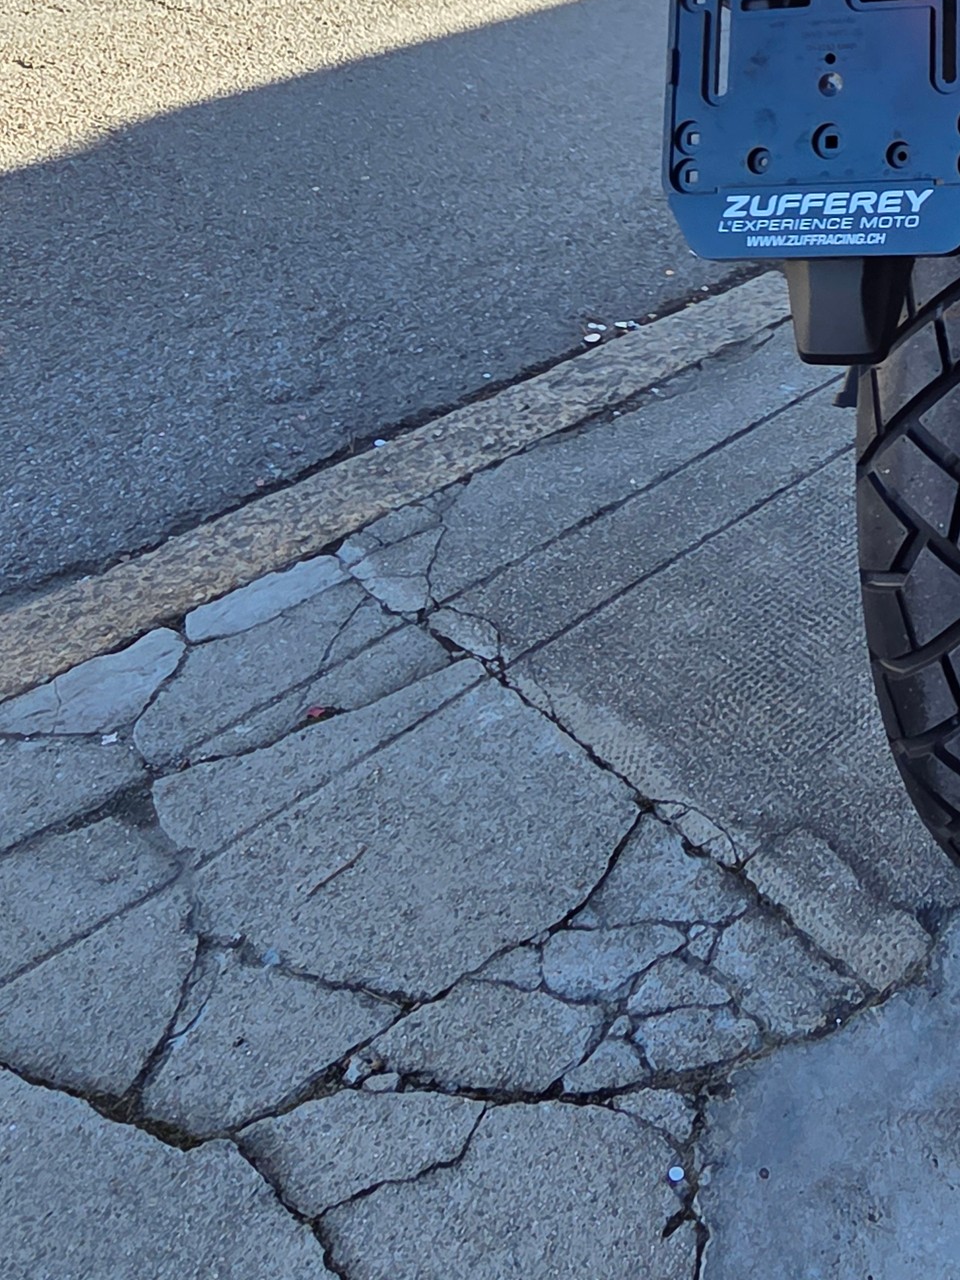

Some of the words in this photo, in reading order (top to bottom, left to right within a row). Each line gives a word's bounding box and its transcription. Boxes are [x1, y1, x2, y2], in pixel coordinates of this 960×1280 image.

[722, 189, 934, 218] ZUFFEREY
[718, 217, 854, 232] L'EXPERIENCE
[859, 215, 920, 229] MOTO
[746, 232, 887, 247] WWW.ZUFFRACING.CH
